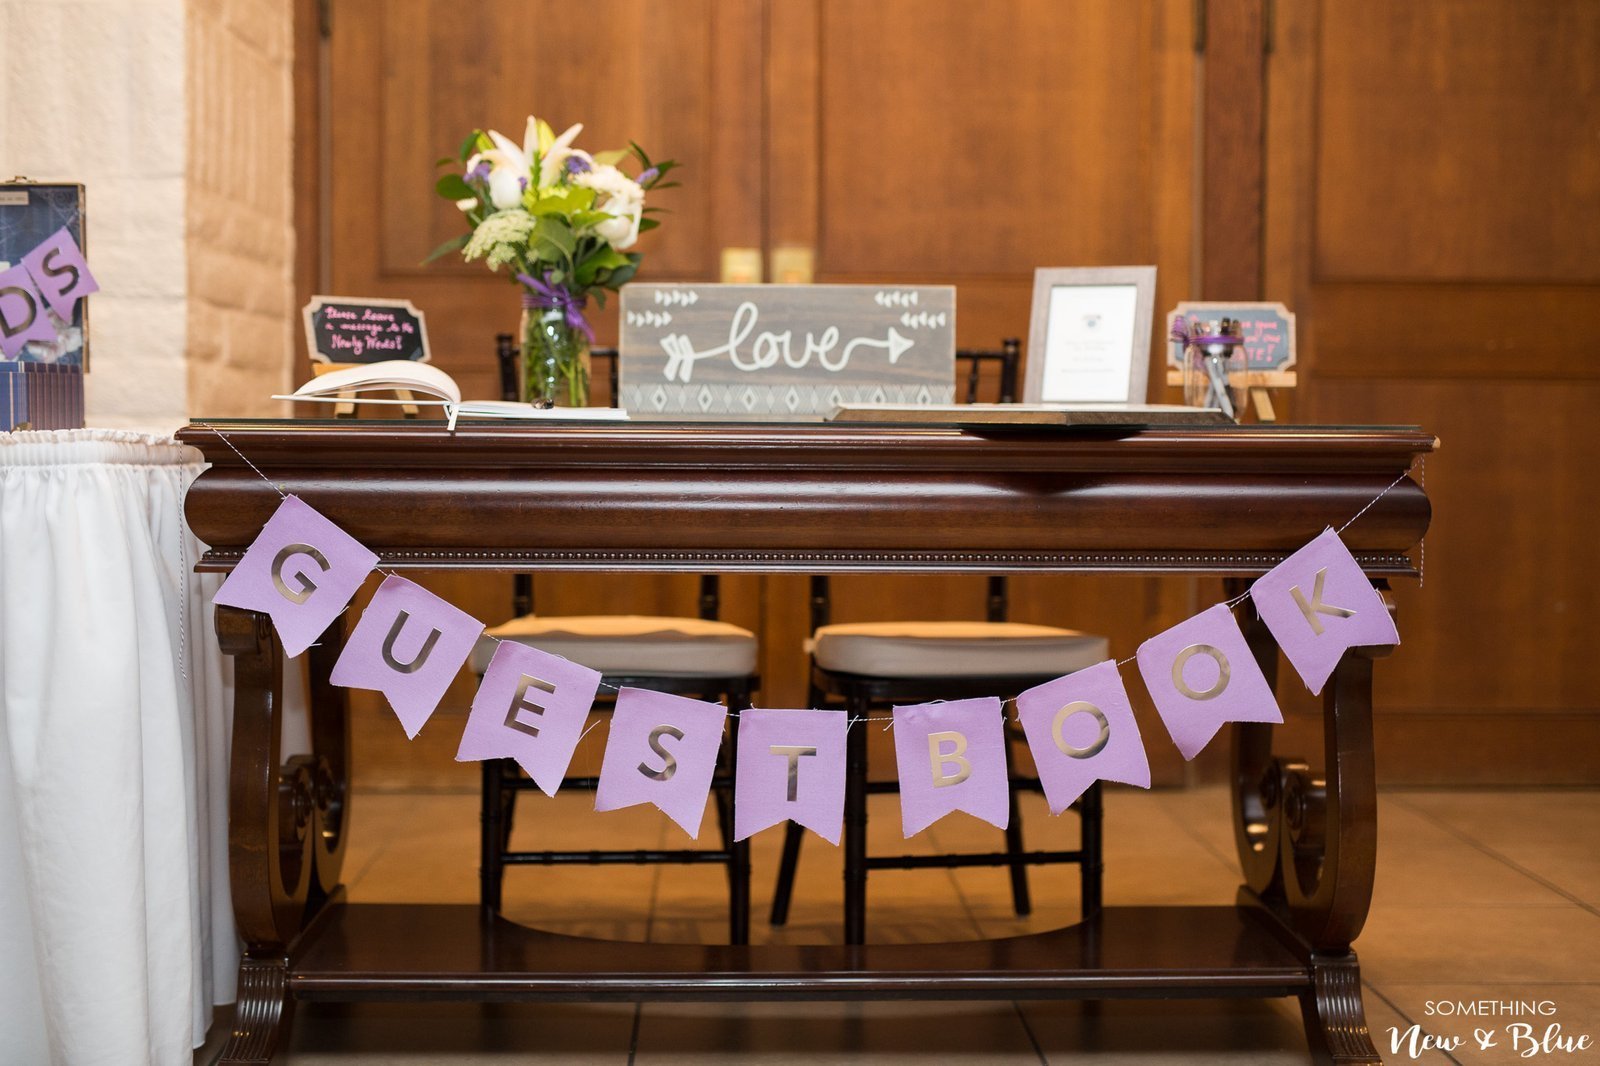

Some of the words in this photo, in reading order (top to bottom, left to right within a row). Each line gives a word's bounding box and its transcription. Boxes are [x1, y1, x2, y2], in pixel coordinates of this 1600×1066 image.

[340, 323, 383, 336] message
[728, 301, 849, 372] love
[331, 334, 363, 355] Newly
